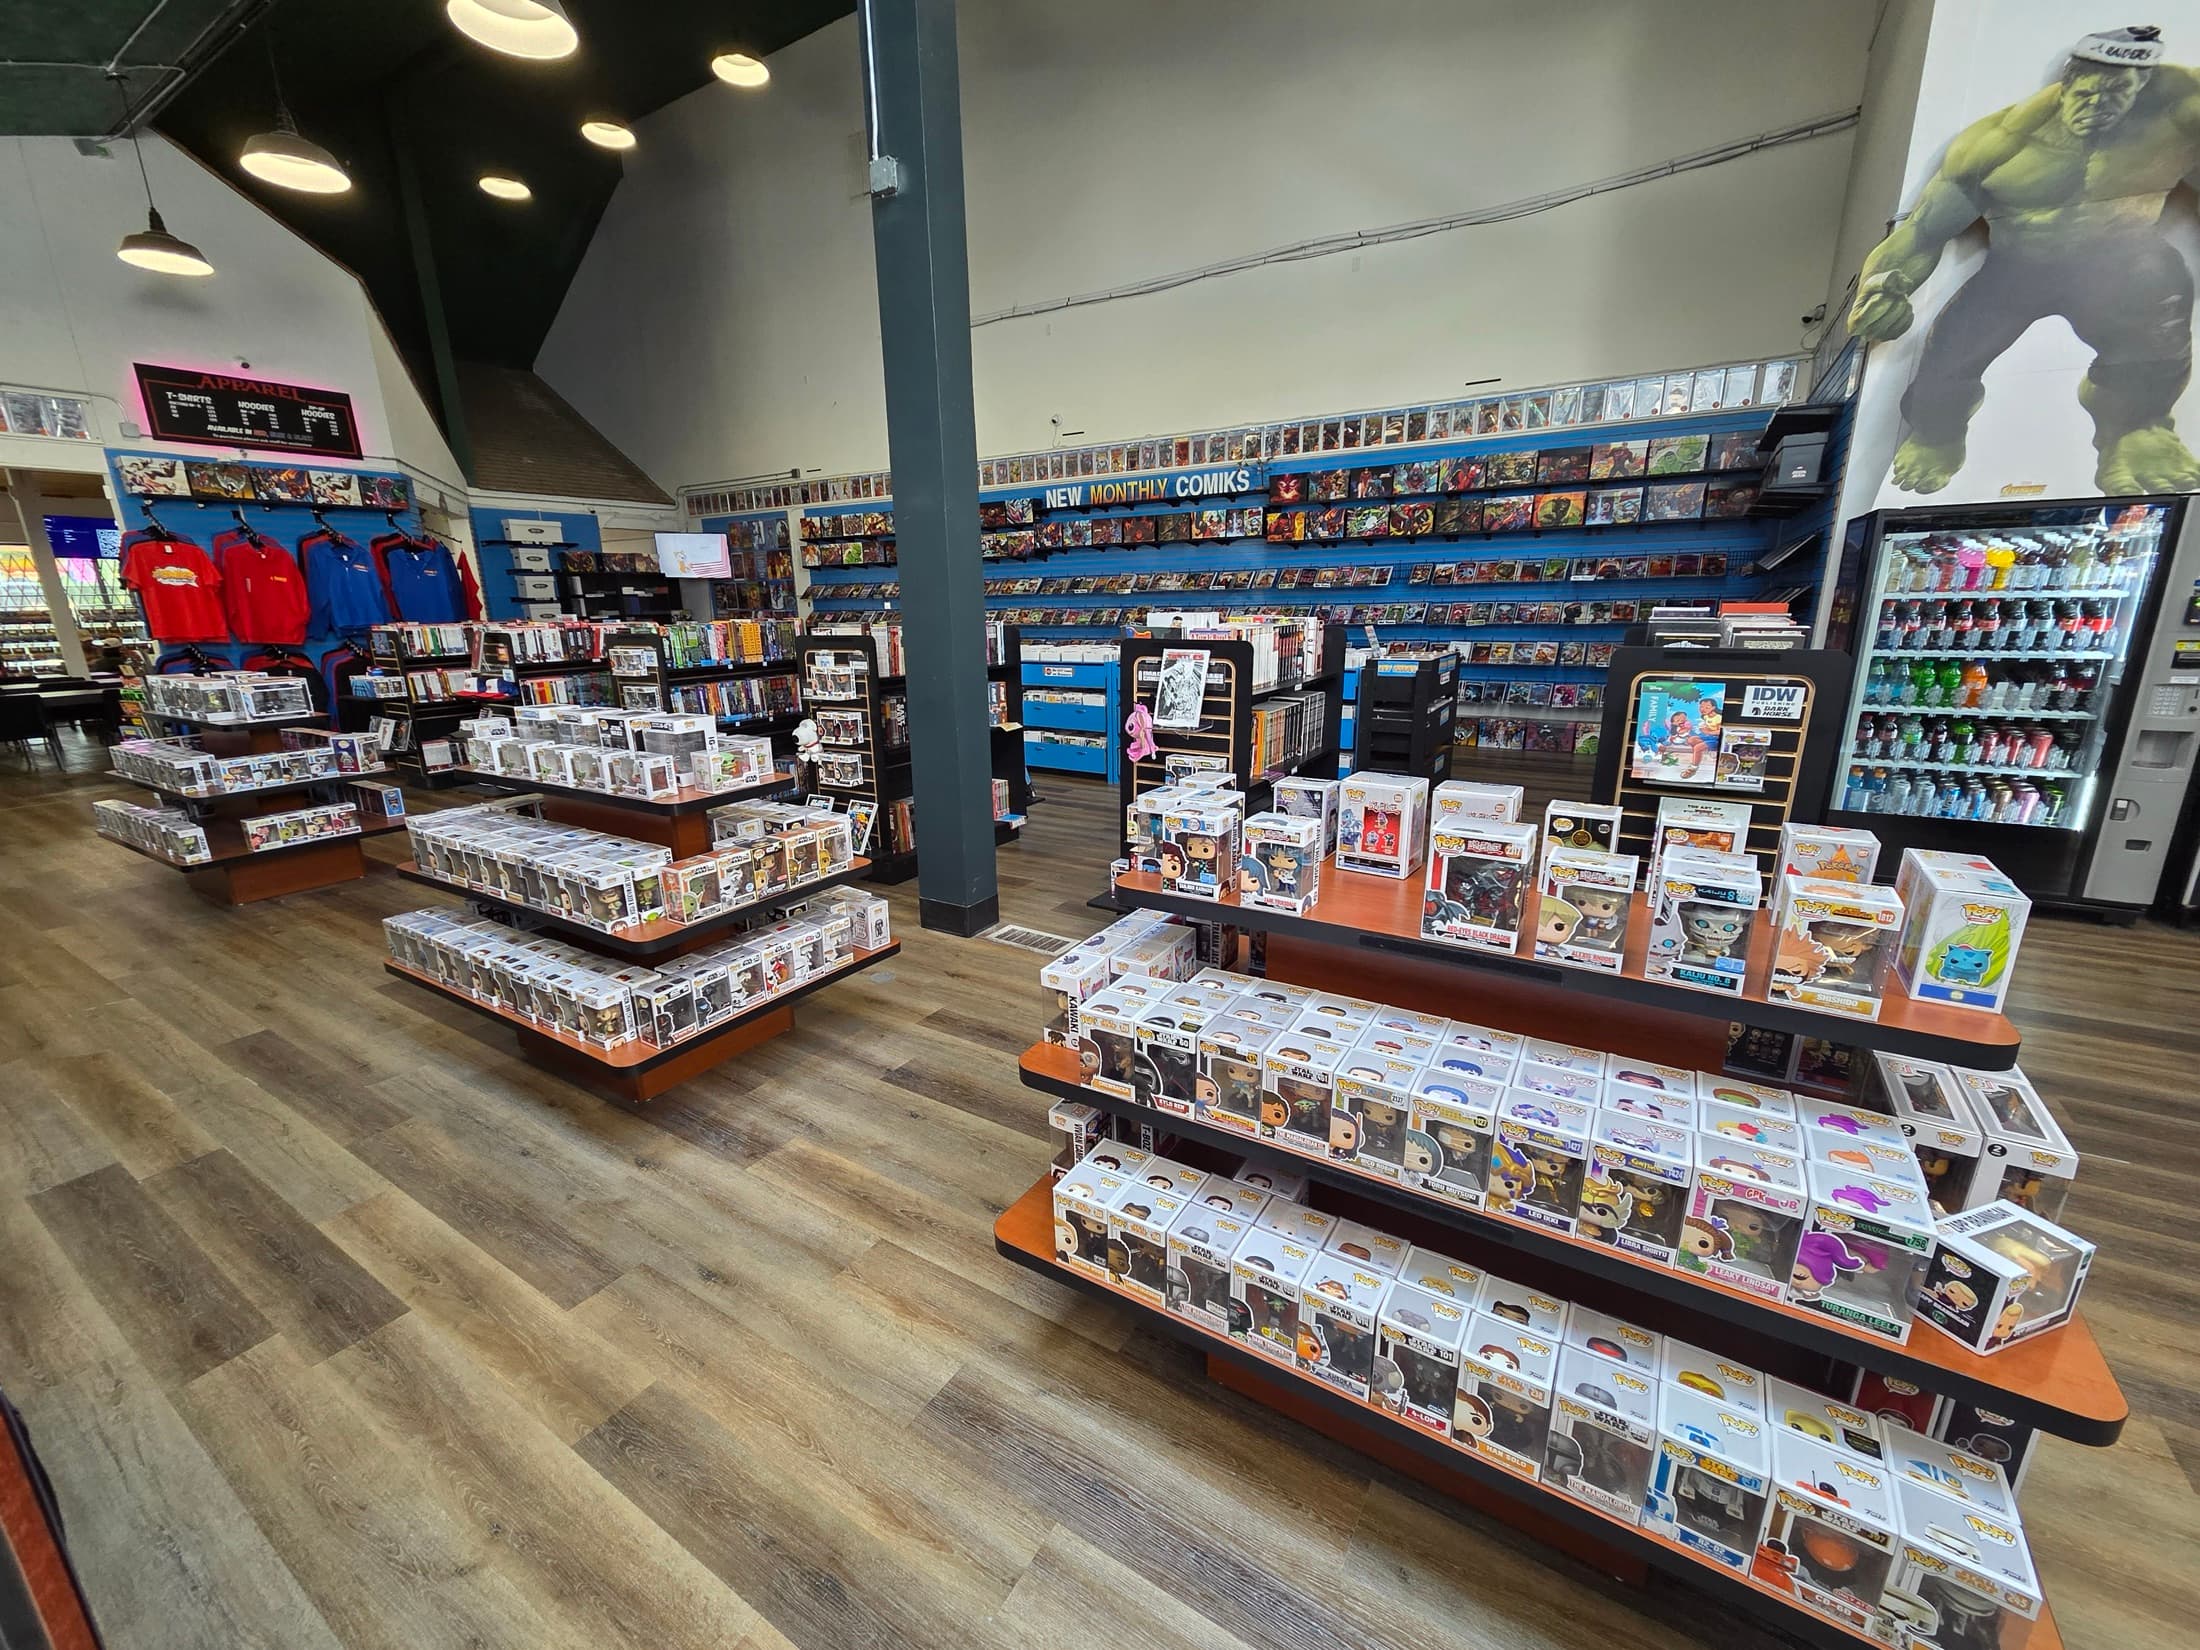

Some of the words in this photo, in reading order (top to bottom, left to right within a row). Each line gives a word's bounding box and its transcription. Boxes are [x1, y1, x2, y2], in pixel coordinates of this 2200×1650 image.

[2105, 46, 2152, 60] RAIDERS
[197, 375, 306, 402] APPAREL
[165, 391, 212, 404] T-SHIRTS
[238, 400, 275, 412] HOODIES
[301, 409, 336, 420] HOODIES
[207, 424, 243, 434] AVAILABLE
[1046, 486, 1082, 508] NEW
[1090, 477, 1168, 504] MONTHLY
[1176, 470, 1250, 497] COMIKS
[1753, 688, 1797, 701] IDW
[1648, 696, 1659, 721] FAMILY
[1440, 800, 1463, 811] POP!
[1434, 835, 1465, 848] POP!
[1796, 843, 1821, 854] POP!
[1550, 866, 1578, 877] POP!
[1664, 881, 1695, 894] POP!
[1794, 899, 1831, 914] POP!
[1961, 904, 2004, 918] POP!
[1447, 924, 1471, 936] RED-EYES
[1472, 930, 1489, 938] BLACK
[1571, 950, 1592, 960] ALEXIS
[1593, 954, 1616, 964] RHODES
[1679, 969, 1706, 981] KAIJU
[1708, 974, 1724, 983] NO.
[1816, 993, 1859, 1007] SHISHIDO
[1068, 996, 1079, 1034] KAWAKI
[1500, 1121, 1529, 1137] POP!
[1143, 1126, 1152, 1152] T-BOZ
[1594, 1146, 1625, 1162] POP!
[1427, 1180, 1444, 1191] TORU
[1445, 1185, 1477, 1200] MUTSUKI
[1698, 1174, 1734, 1191] POP!
[1746, 1189, 1766, 1200] GPK
[1528, 1209, 1542, 1219] LEO
[1543, 1213, 1558, 1224] IKKI
[1816, 1207, 1855, 1223] POP!
[1620, 1237, 1640, 1249] LIBRA
[1642, 1243, 1667, 1257] SHIRYU
[1713, 1265, 1739, 1281] LEAKY
[1741, 1275, 1777, 1291] LINDSAY
[1820, 1300, 1866, 1322] TURANGA
[1869, 1316, 1899, 1333] LEELA
[1618, 1327, 1652, 1344] POP!
[1439, 1349, 1453, 1360] 101
[1518, 1338, 1550, 1355] POP!
[1717, 1364, 1755, 1385] POP!
[1613, 1374, 1648, 1392] POP!
[1559, 1399, 1590, 1418] POP!
[1412, 1409, 1437, 1426] 4-LOM
[1594, 1415, 1629, 1431] WARS
[1595, 1410, 1627, 1425] STAR
[1719, 1414, 1759, 1436] POP!
[1826, 1406, 1866, 1428] POP!
[1486, 1444, 1504, 1457] HAN
[1507, 1451, 1527, 1468] SOLO
[1663, 1441, 1695, 1462] POP!
[1703, 1456, 1733, 1471] STAR
[1949, 1455, 1995, 1479] POP!
[1699, 1463, 1739, 1481] WARS
[1835, 1463, 1879, 1488] POP!
[1570, 1480, 1586, 1492] THE
[1778, 1490, 1816, 1513] POP!
[1821, 1510, 1861, 1528] STAR
[1824, 1516, 1860, 1534] WARS
[1964, 1516, 2013, 1542] POP!
[1698, 1538, 1725, 1553] R2-D2
[1903, 1546, 1949, 1573] POP!
